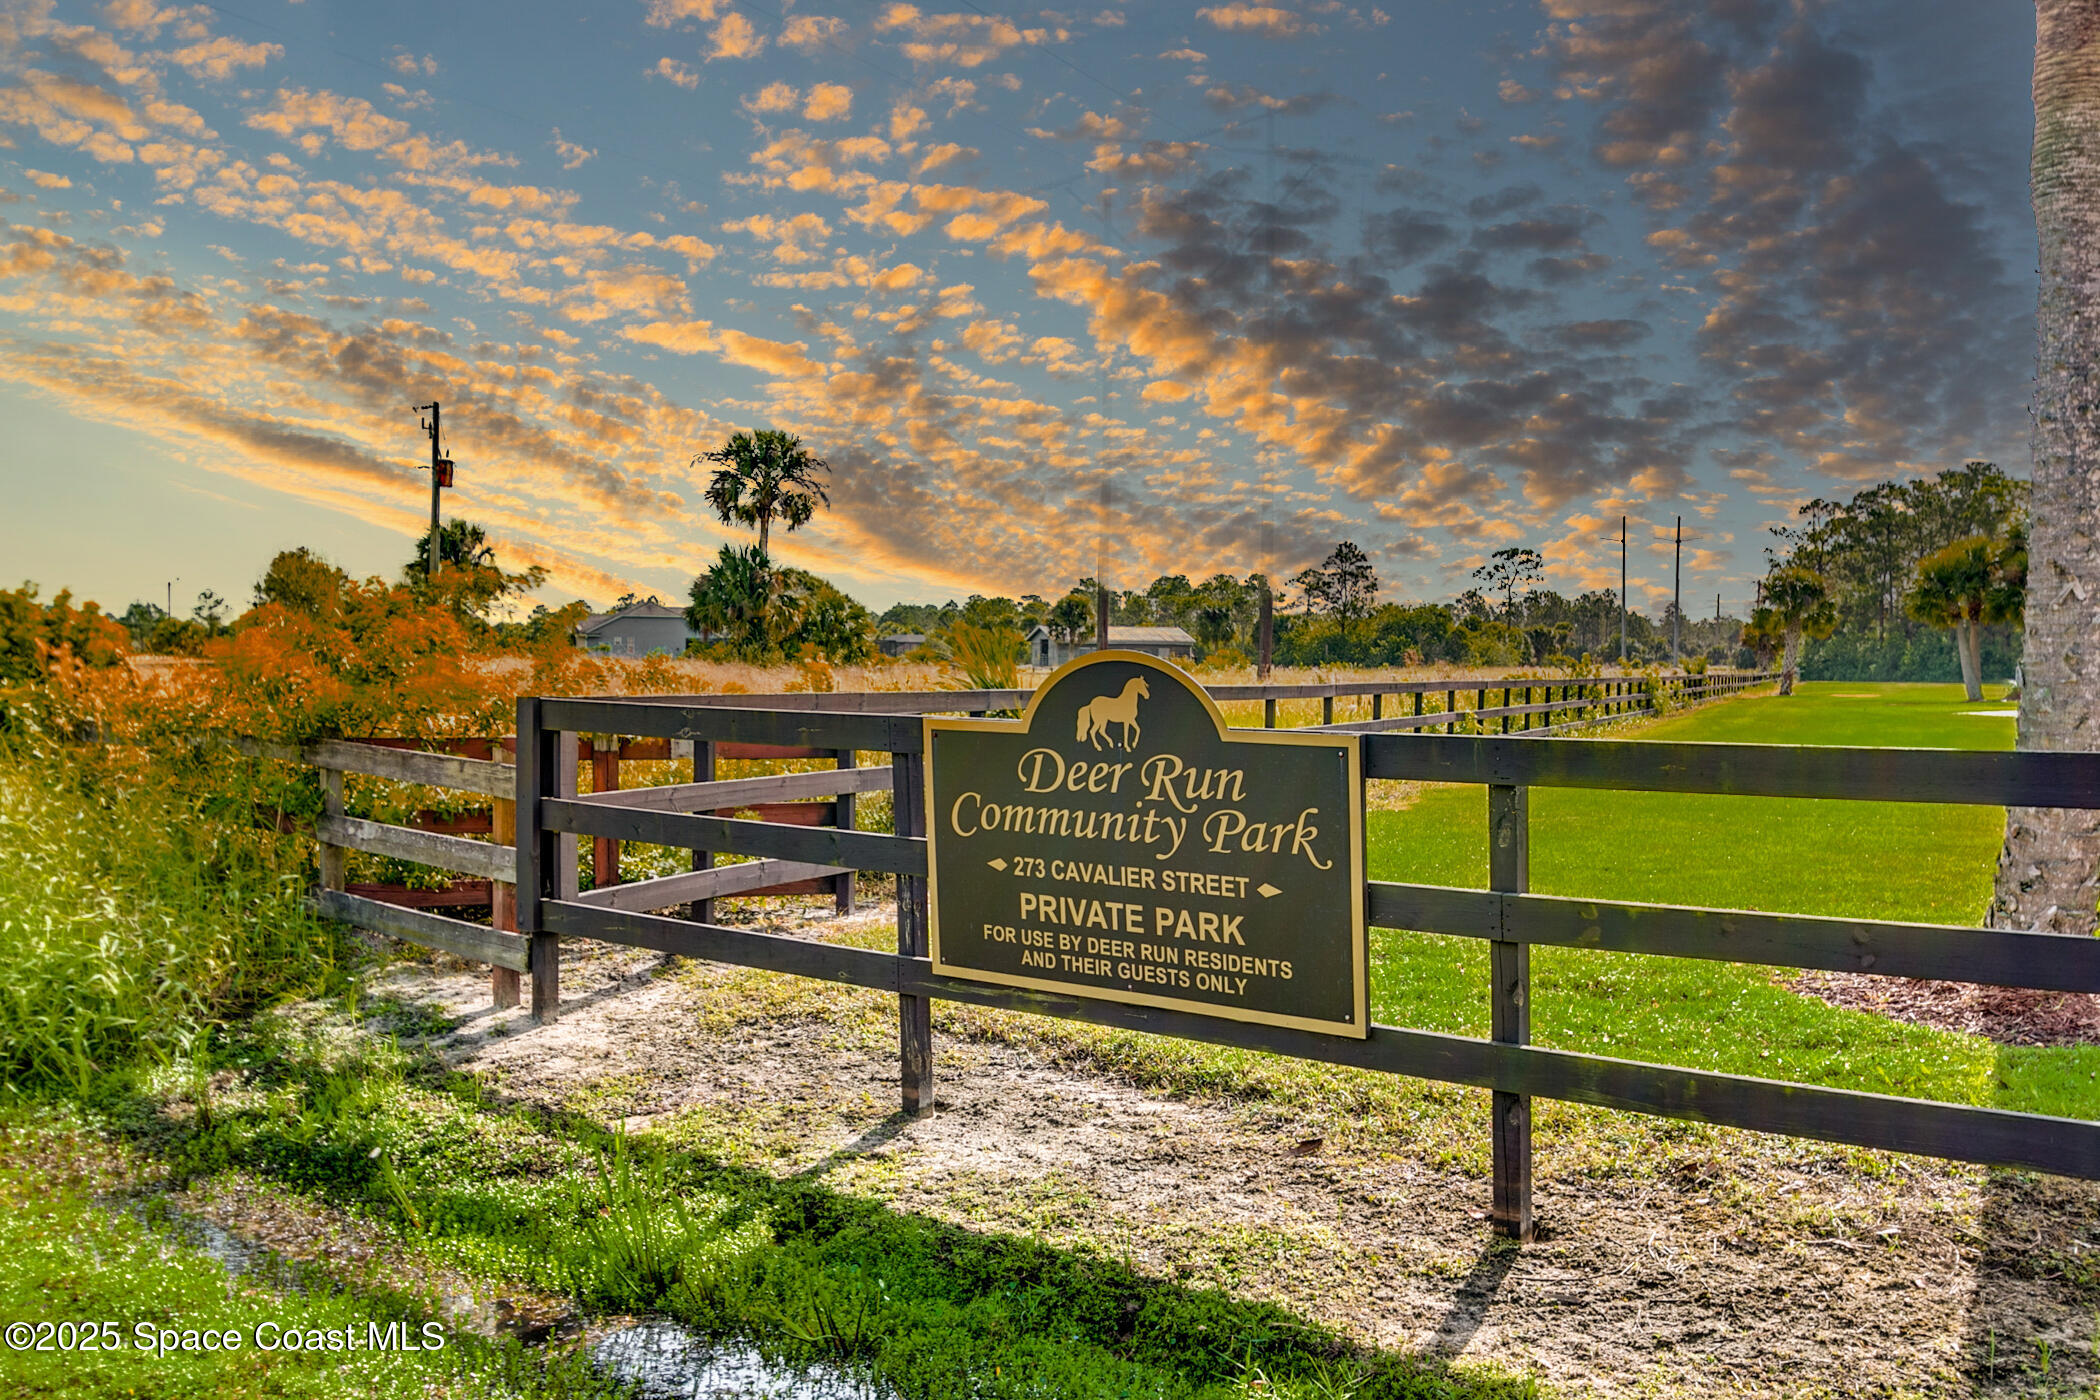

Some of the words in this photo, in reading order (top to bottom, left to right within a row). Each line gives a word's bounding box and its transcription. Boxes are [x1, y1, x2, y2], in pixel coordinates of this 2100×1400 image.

[1017, 747, 1133, 794] Deer
[1140, 754, 1247, 814] Run
[951, 791, 1187, 860] Community
[1202, 807, 1333, 870] Park
[1013, 856, 1046, 879] 273
[1051, 859, 1157, 890] CAVALIER
[1161, 870, 1250, 899] STREET
[1020, 892, 1145, 934] PRIVATE
[1155, 906, 1246, 946] PARK
[983, 924, 1017, 944] FOR
[1021, 928, 1055, 949] USE
[1059, 933, 1082, 952] BY
[1087, 937, 1136, 959] DEER
[1140, 943, 1179, 965] RUN
[1184, 949, 1293, 980] RESIDENTS
[1021, 949, 1057, 969] AND
[1060, 954, 1113, 977] THEIR
[1117, 962, 1191, 988] GUESTS
[1195, 972, 1248, 996] ONLY
